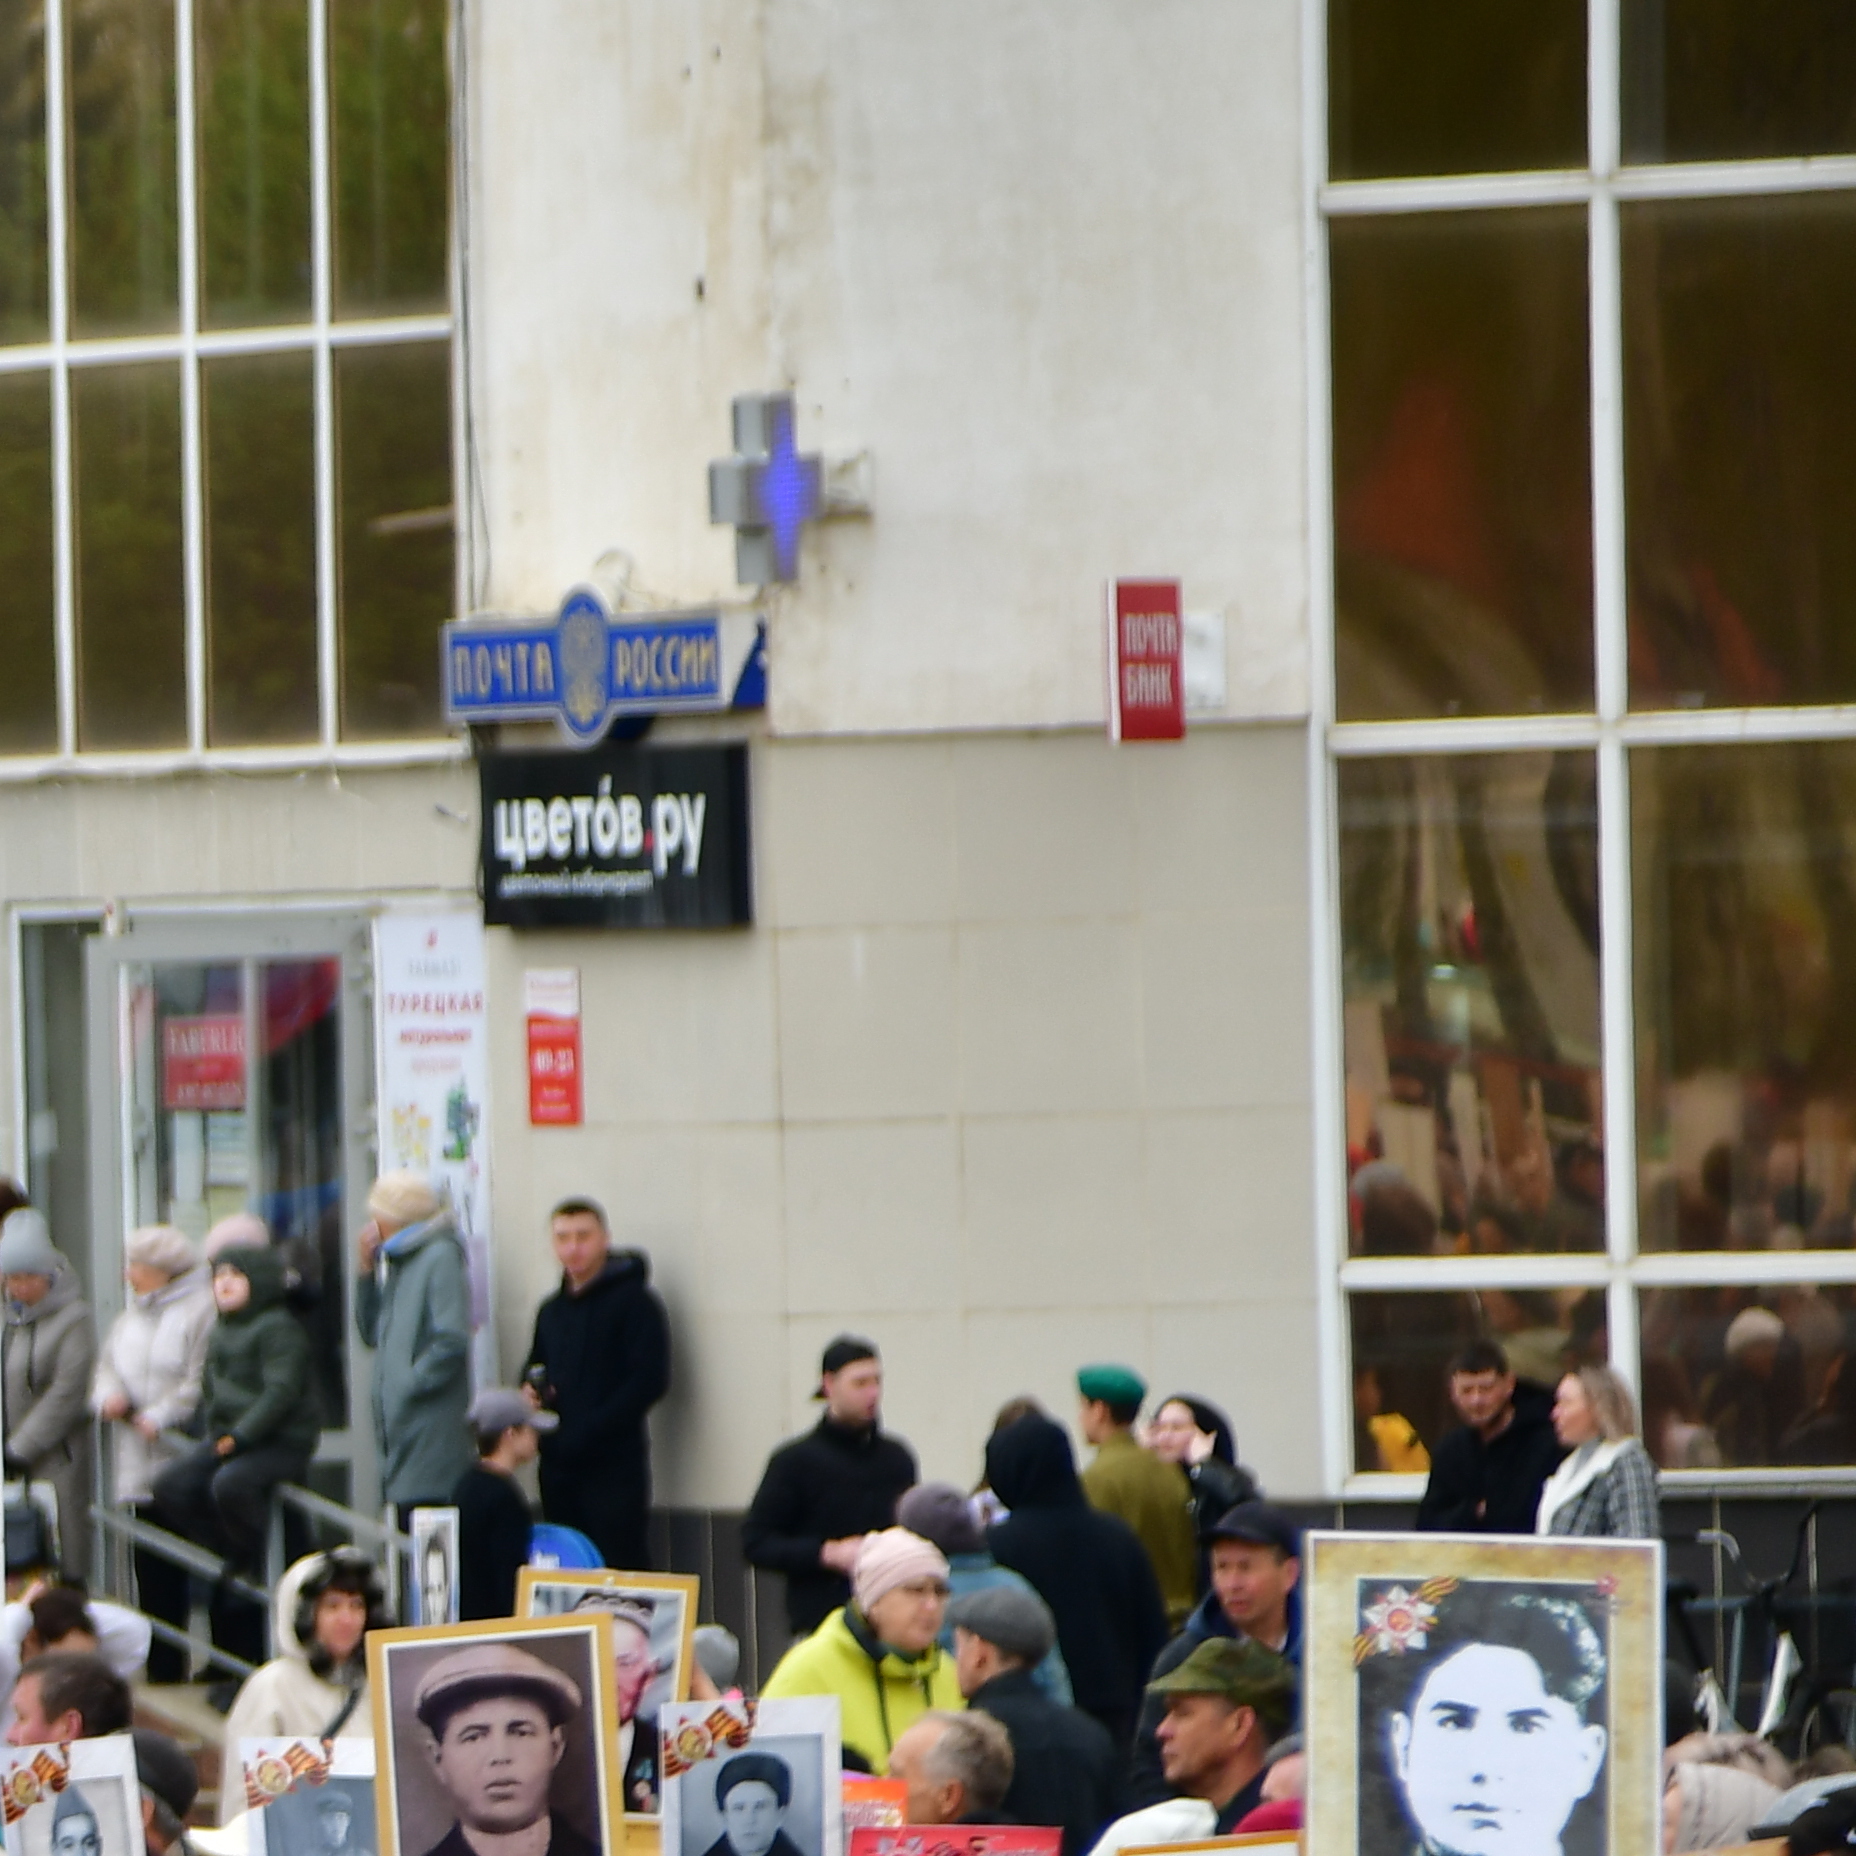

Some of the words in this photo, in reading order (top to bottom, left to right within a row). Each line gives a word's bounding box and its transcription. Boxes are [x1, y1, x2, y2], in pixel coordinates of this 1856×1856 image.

[453, 641, 555, 696] ПОЧТА
[615, 633, 718, 689] РОССИИ
[385, 989, 483, 1016] ТУРЕЦКАЯ
